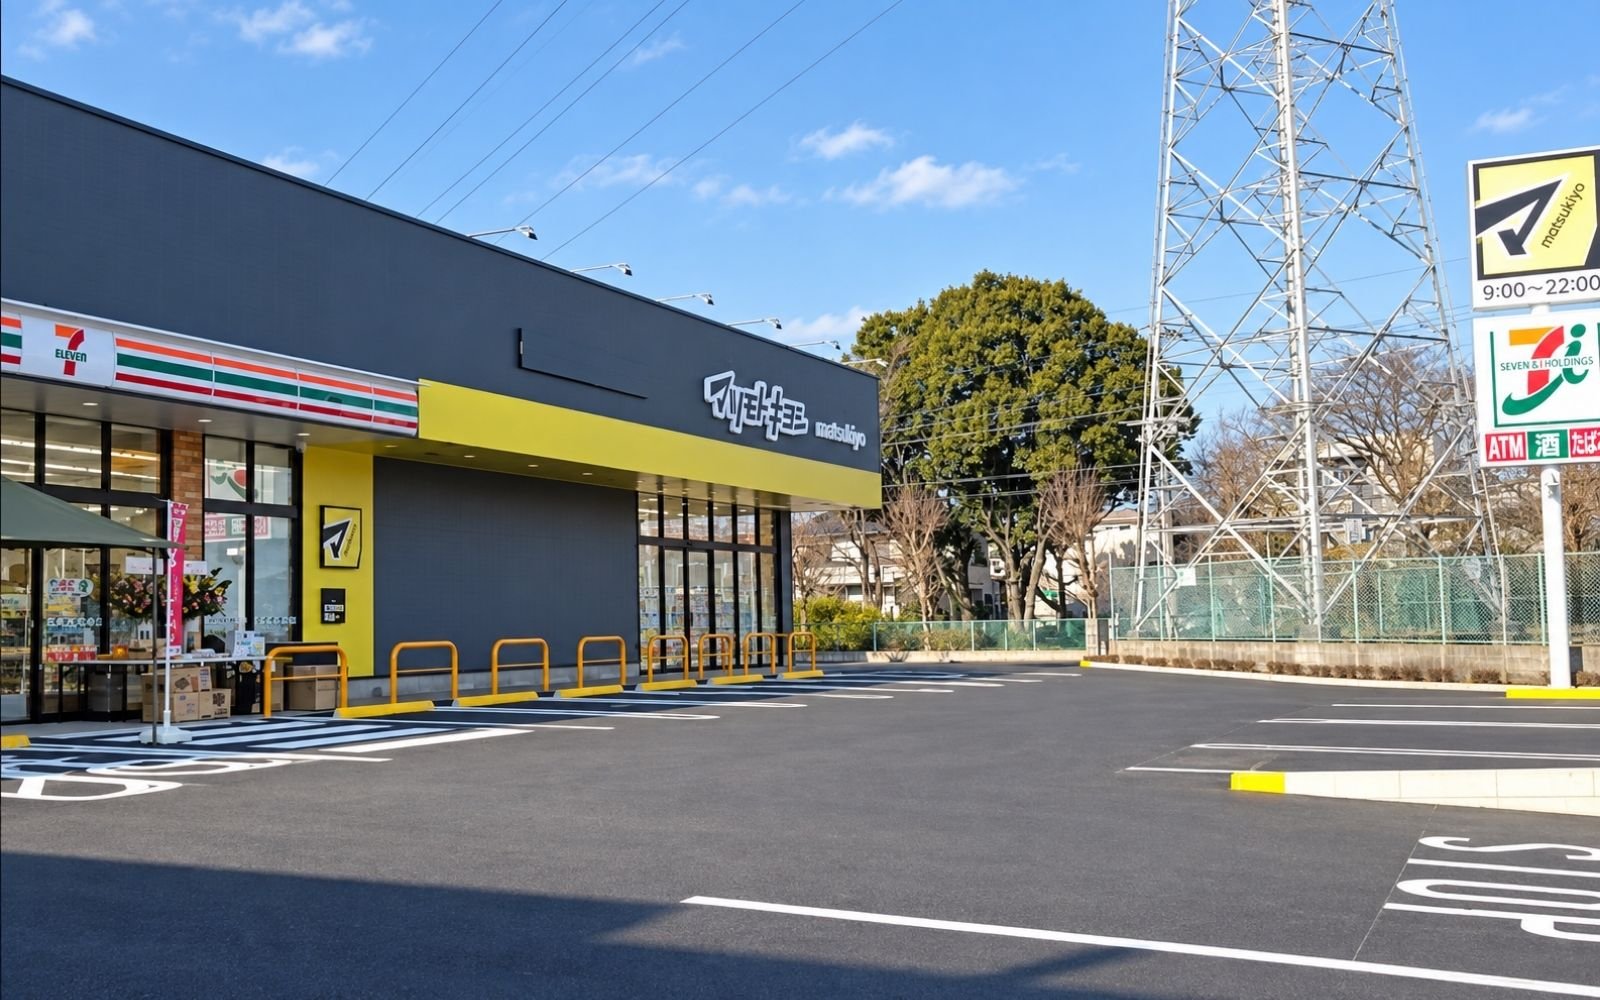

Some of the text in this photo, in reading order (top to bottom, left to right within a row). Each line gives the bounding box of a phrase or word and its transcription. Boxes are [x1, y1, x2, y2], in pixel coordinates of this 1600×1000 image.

[1541, 183, 1585, 248] matsukiyo
[1500, 361, 1530, 371] SEVEN
[1531, 360, 1539, 369] &
[1545, 356, 1594, 368] HOLDINGS
[815, 421, 866, 450] matsukiyo
[1488, 434, 1524, 460] ATM
[1535, 433, 1560, 457] 酒
[1572, 430, 1600, 455] たば
